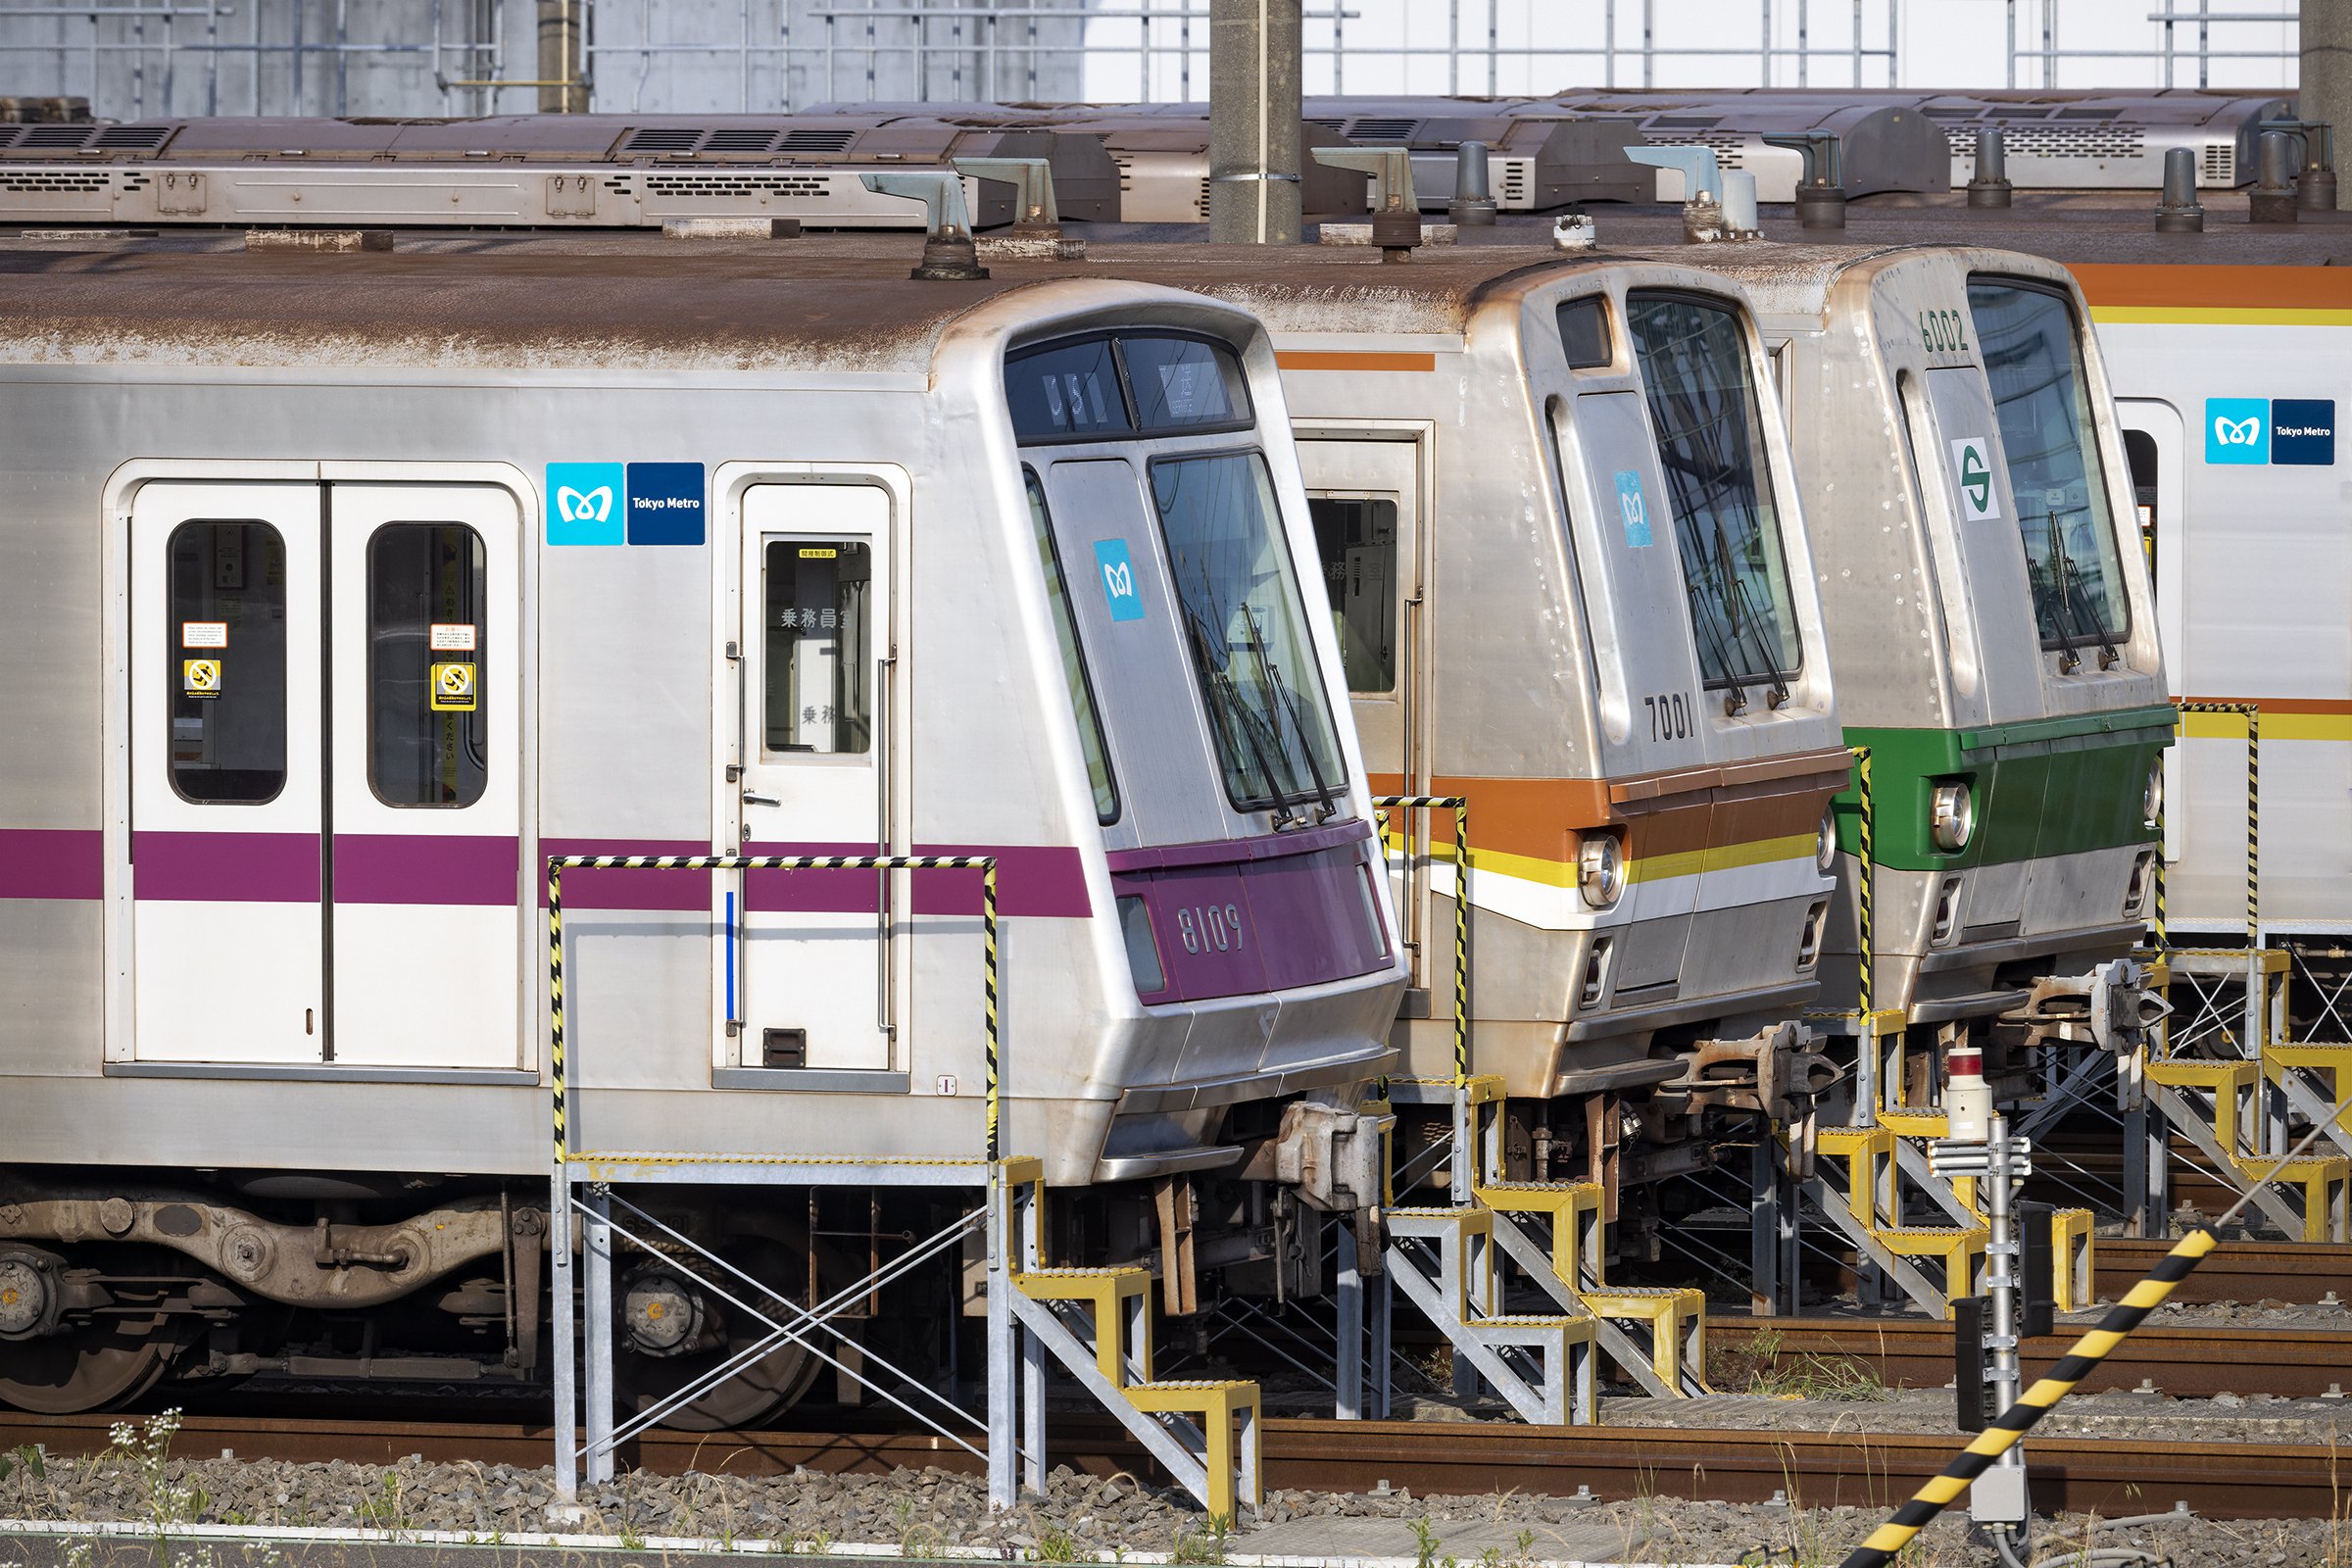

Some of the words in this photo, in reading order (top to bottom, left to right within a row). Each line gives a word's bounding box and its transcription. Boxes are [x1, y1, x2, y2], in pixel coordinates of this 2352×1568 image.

[1919, 309, 1969, 353] 6002
[2276, 425, 2303, 438] Tokyo
[2303, 425, 2331, 437] Metro
[632, 497, 665, 511] Tokyo
[666, 497, 700, 509] Metro
[1643, 691, 1693, 743] 7001
[1177, 903, 1244, 955] 8109
